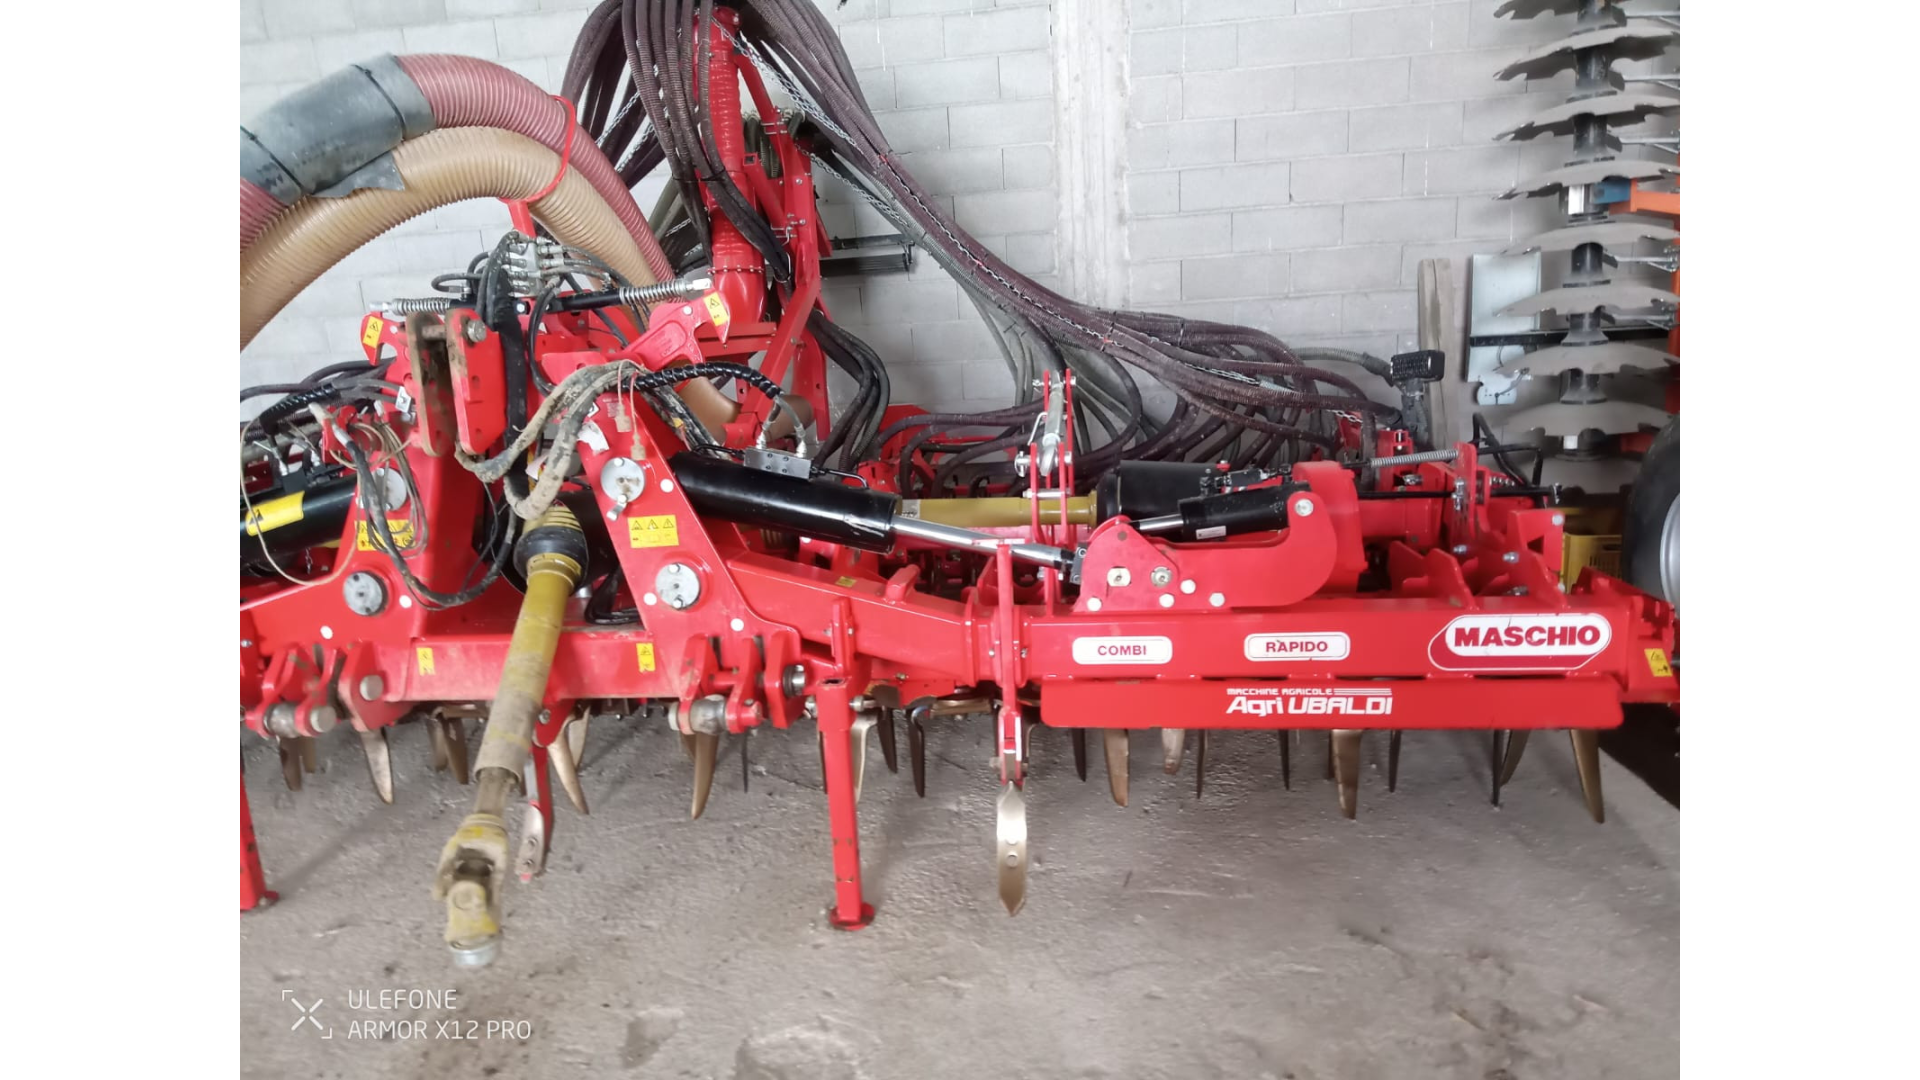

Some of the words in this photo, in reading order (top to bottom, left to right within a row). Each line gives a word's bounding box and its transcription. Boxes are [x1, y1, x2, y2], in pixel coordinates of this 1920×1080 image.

[1454, 625, 1601, 647] MASCHIO
[1097, 644, 1147, 656] COMBI
[1265, 641, 1328, 653] RAPIDO
[1226, 688, 1279, 696] MACCHINE
[1281, 688, 1333, 696] AGRICOLE
[1225, 696, 1284, 717] Agri
[1287, 697, 1393, 715] UBALDI
